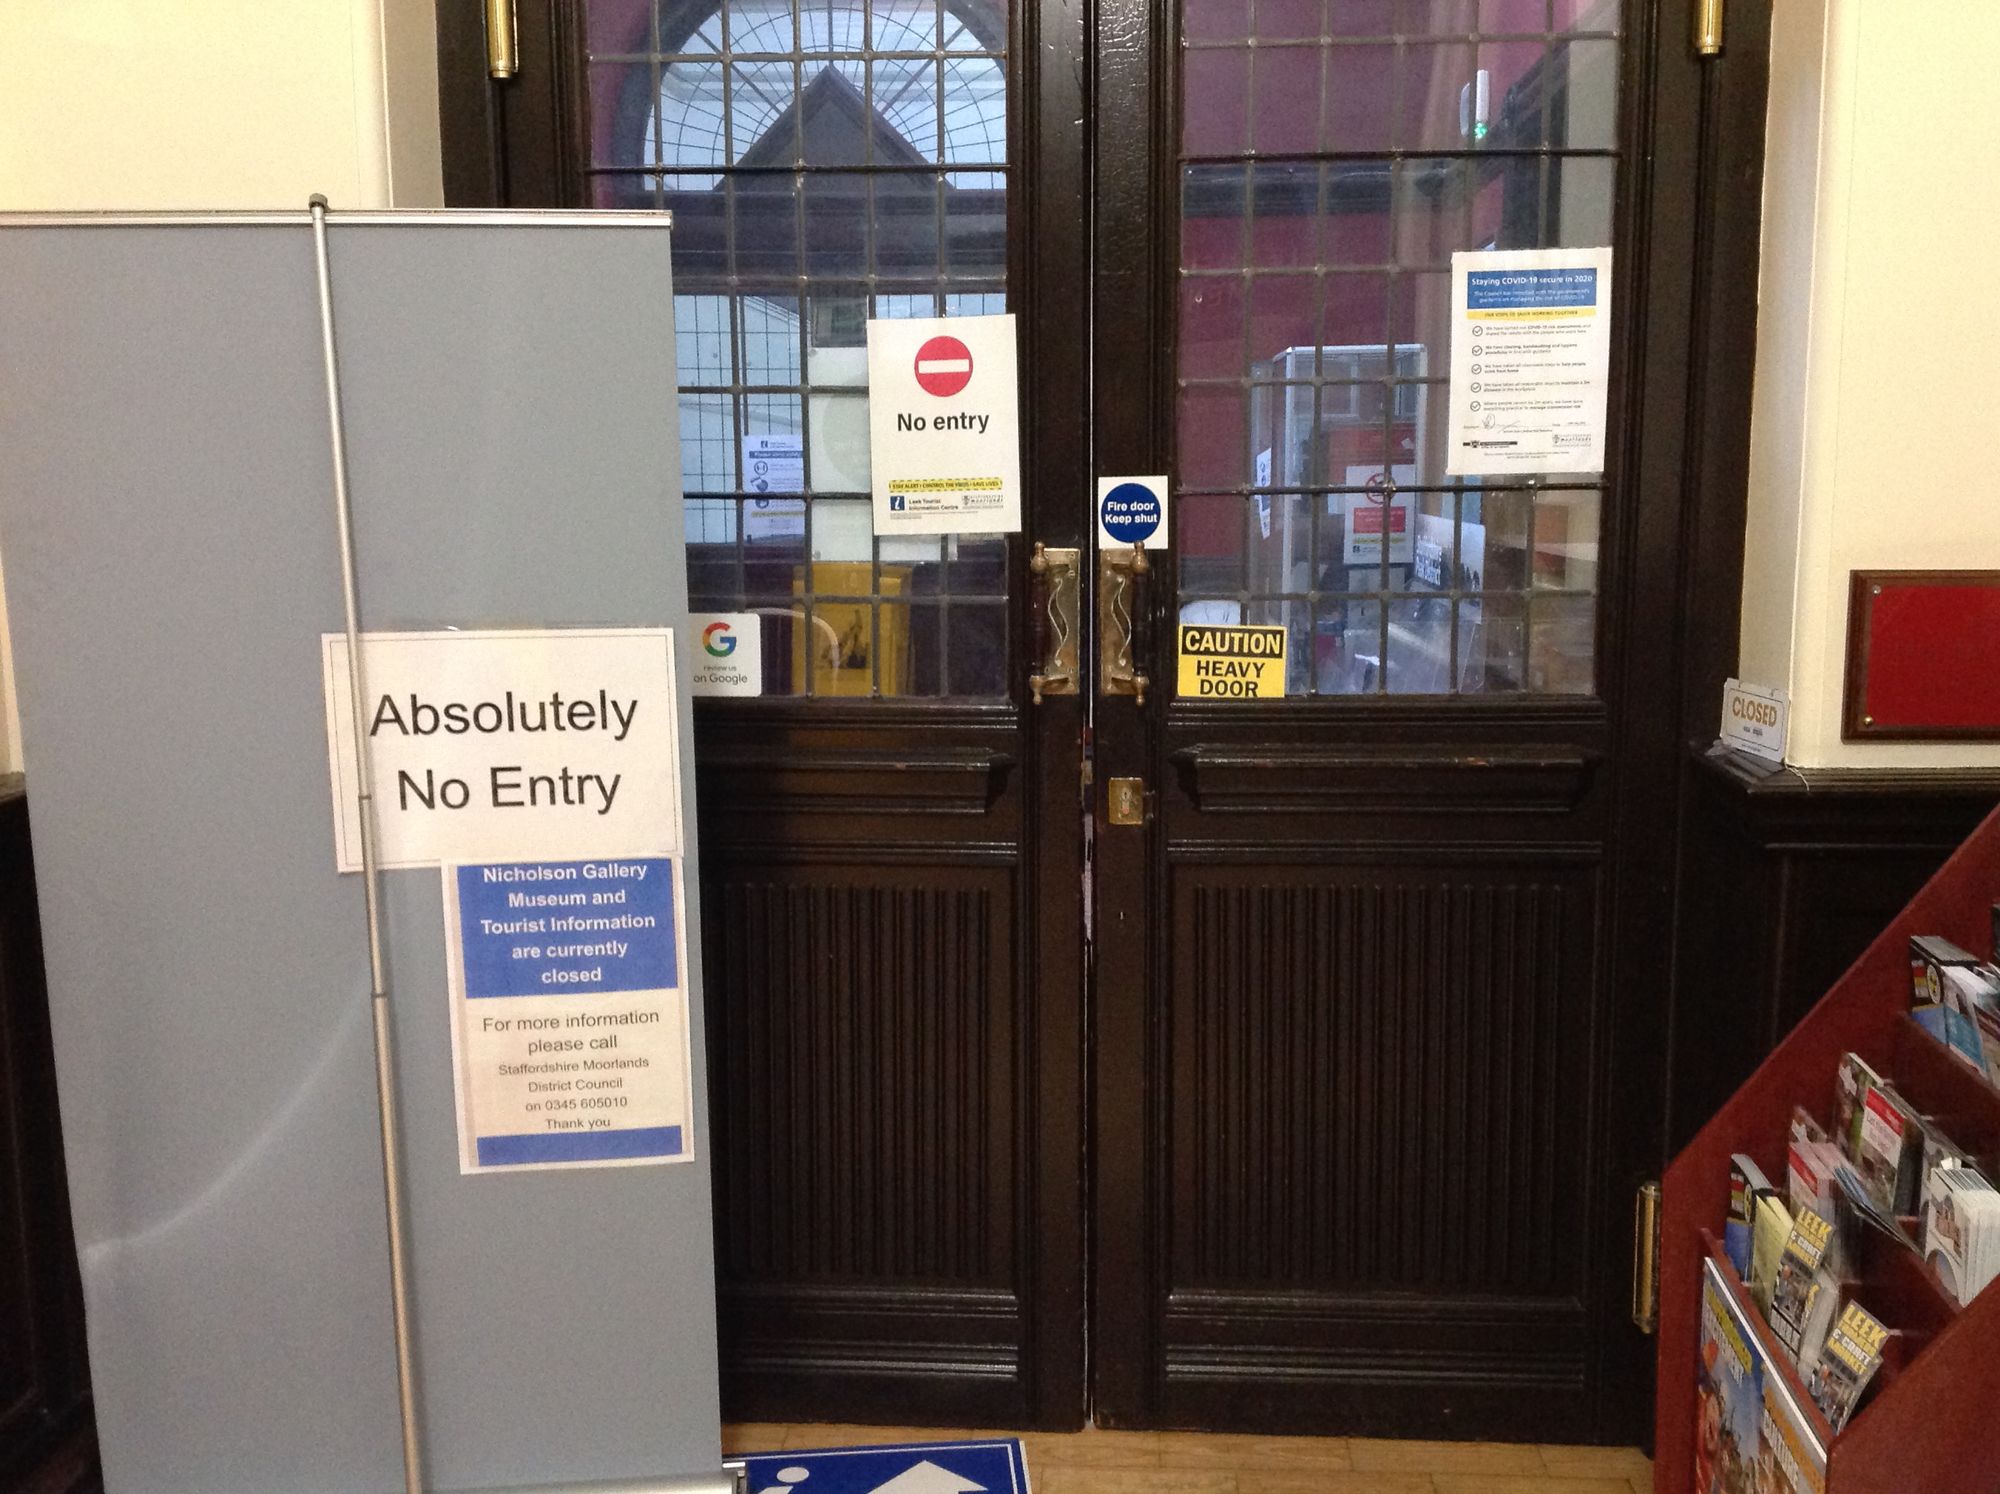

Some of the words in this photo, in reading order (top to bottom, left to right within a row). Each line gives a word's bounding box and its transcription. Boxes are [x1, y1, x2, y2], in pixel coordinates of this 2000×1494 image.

[1472, 278, 1500, 286] Staying
[1502, 276, 1538, 285] COVID-19
[897, 413, 926, 432] No
[933, 412, 990, 434] entry
[1107, 502, 1128, 512] Fire
[1130, 501, 1155, 512] door
[1105, 514, 1132, 525] Keep
[1134, 512, 1158, 523] shut
[1185, 630, 1281, 654] CAUTION
[1196, 660, 1266, 679] HEAVY
[693, 674, 707, 683] on
[709, 673, 748, 686] Google
[1200, 679, 1258, 697] DOOR
[369, 689, 638, 741] Absolutely
[1732, 696, 1778, 728] CLOSED
[398, 768, 470, 811] No
[490, 766, 622, 815] Entry
[483, 866, 577, 883] Nicholson
[582, 863, 648, 881] Gallery
[508, 892, 586, 908] Museum
[592, 889, 626, 905] and
[480, 918, 546, 934] Tourist
[551, 914, 656, 932] Information
[512, 946, 541, 959] are
[546, 940, 628, 958] currently
[541, 967, 602, 984] closed
[483, 1017, 512, 1032] For
[517, 1016, 560, 1030] more
[566, 1010, 660, 1028] information
[528, 1037, 584, 1056] please
[589, 1034, 618, 1050] call
[498, 1062, 579, 1076] Staffordshire
[583, 1057, 650, 1072] Moorlands
[528, 1080, 572, 1092] District
[575, 1078, 623, 1090] Council
[525, 1102, 541, 1112] on
[545, 1099, 577, 1112] 0345
[580, 1096, 628, 1109] 605010
[546, 1118, 584, 1130] Thank
[588, 1118, 611, 1130] you
[1843, 1304, 1888, 1348] LEEK
